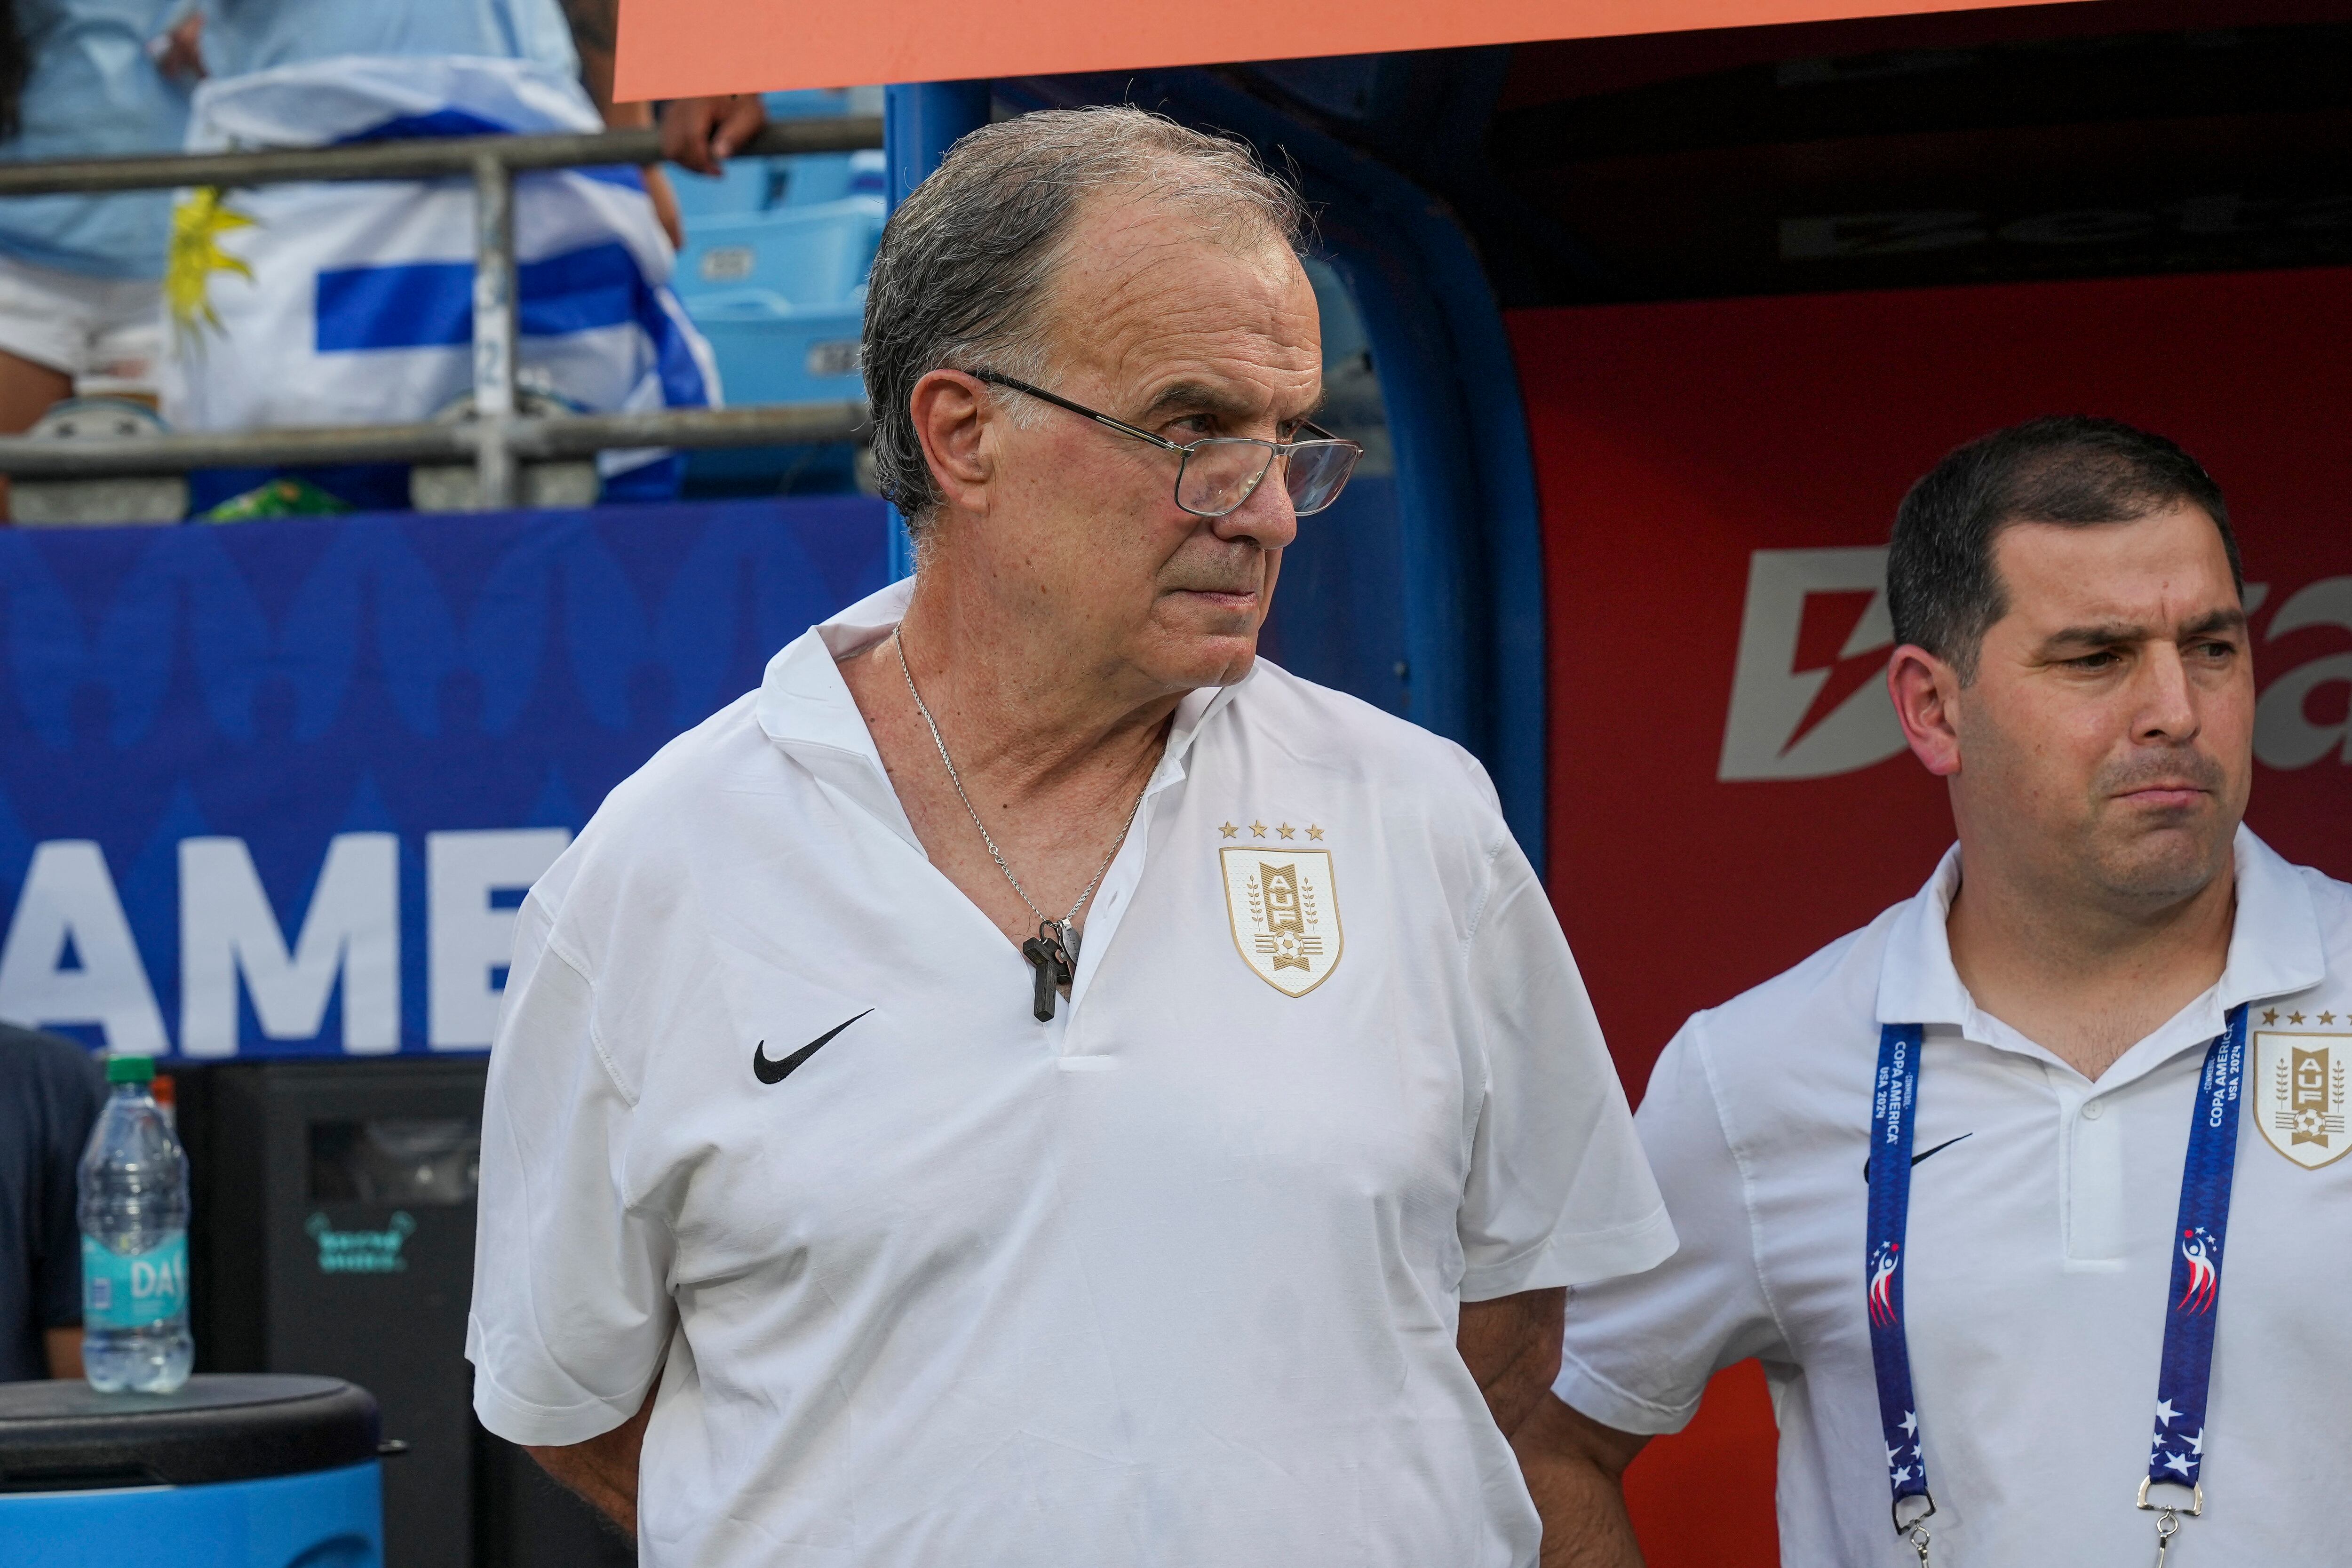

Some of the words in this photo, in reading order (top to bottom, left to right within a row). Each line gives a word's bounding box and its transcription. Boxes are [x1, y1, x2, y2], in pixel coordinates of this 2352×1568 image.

[1269, 876, 1296, 924] AUF
[1891, 1041, 1907, 1078] COPA
[2215, 1023, 2234, 1086] AMERICA
[2230, 1045, 2241, 1074] 2024
[1877, 1067, 1890, 1089] USA
[2227, 1077, 2239, 1100] USA
[2298, 1058, 2322, 1104] AUF
[1875, 1090, 1887, 1119] 2024
[1886, 1080, 1902, 1144] AMERICA
[2209, 1089, 2225, 1128] COPA
